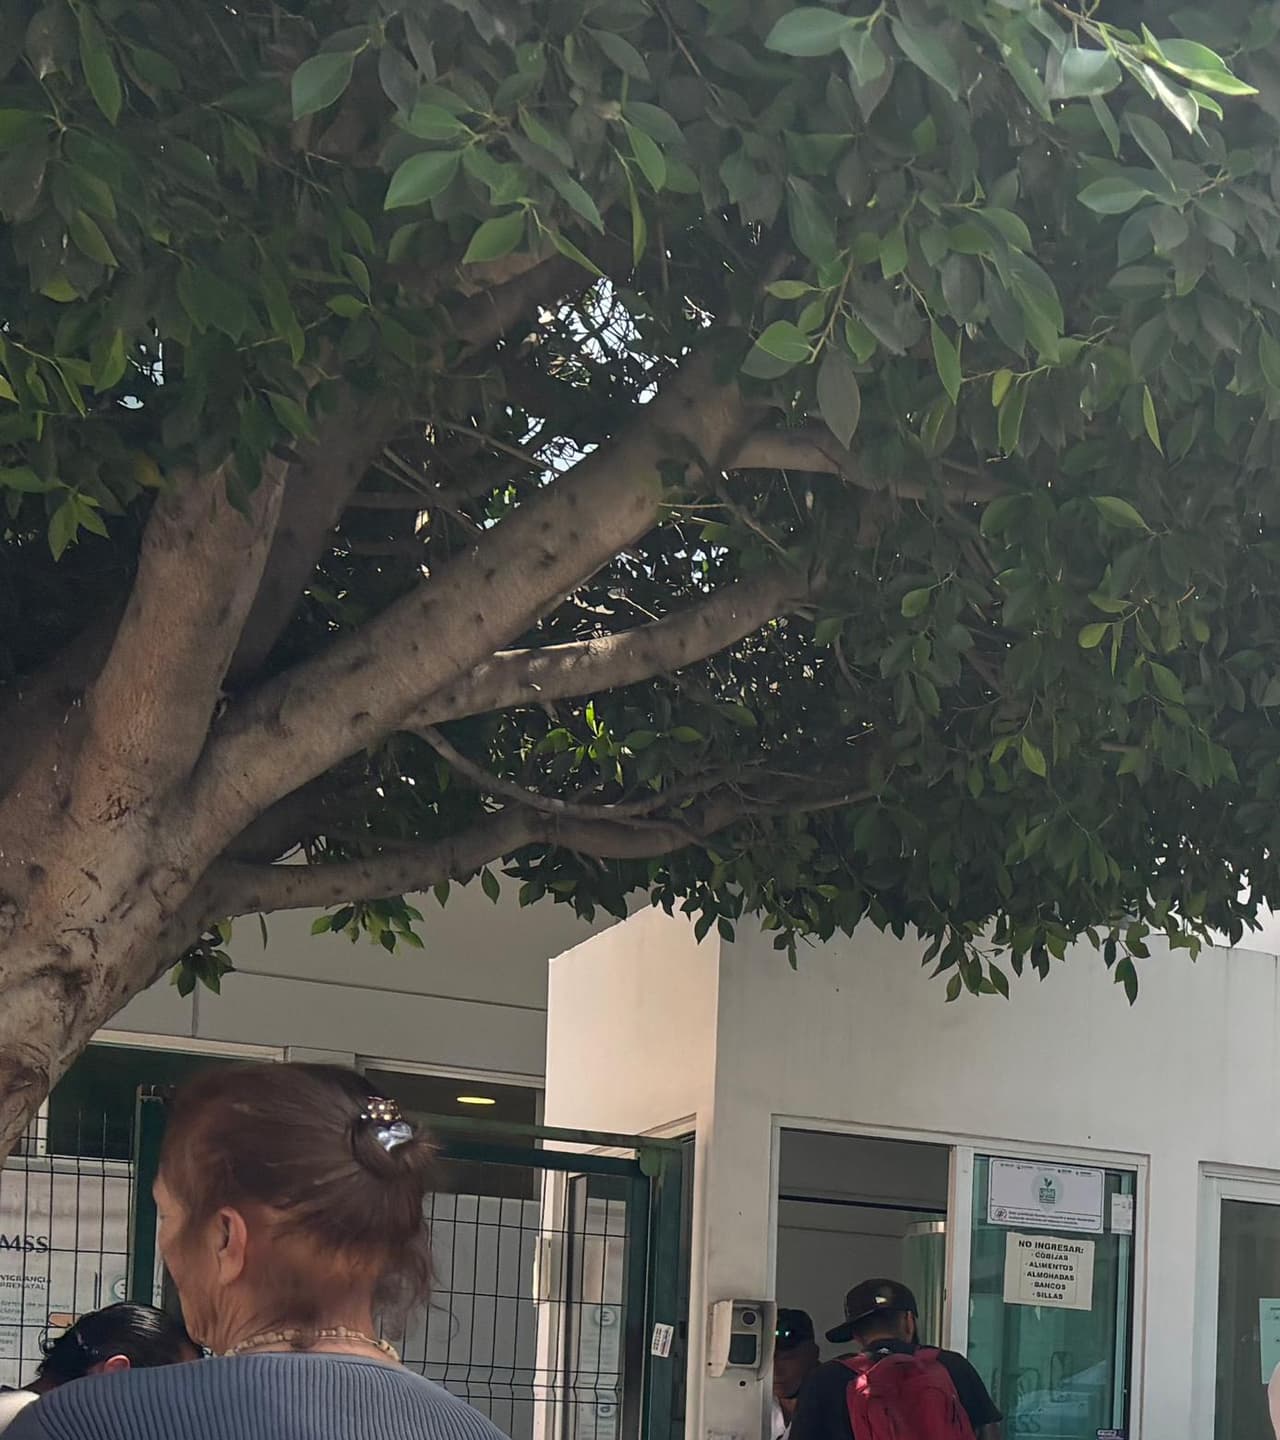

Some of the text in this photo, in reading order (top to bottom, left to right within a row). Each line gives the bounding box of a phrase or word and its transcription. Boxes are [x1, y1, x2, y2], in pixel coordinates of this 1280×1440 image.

[0, 1235, 49, 1253] MSS
[1018, 1240, 1084, 1254] NO INGRESAR:
[1034, 1251, 1069, 1261] COBIJAS
[1028, 1261, 1074, 1272] ALIMENTOS
[1026, 1271, 1075, 1281] ALMOHADAS
[1033, 1281, 1067, 1290] BANCOS
[1036, 1291, 1064, 1300] SILLAS
